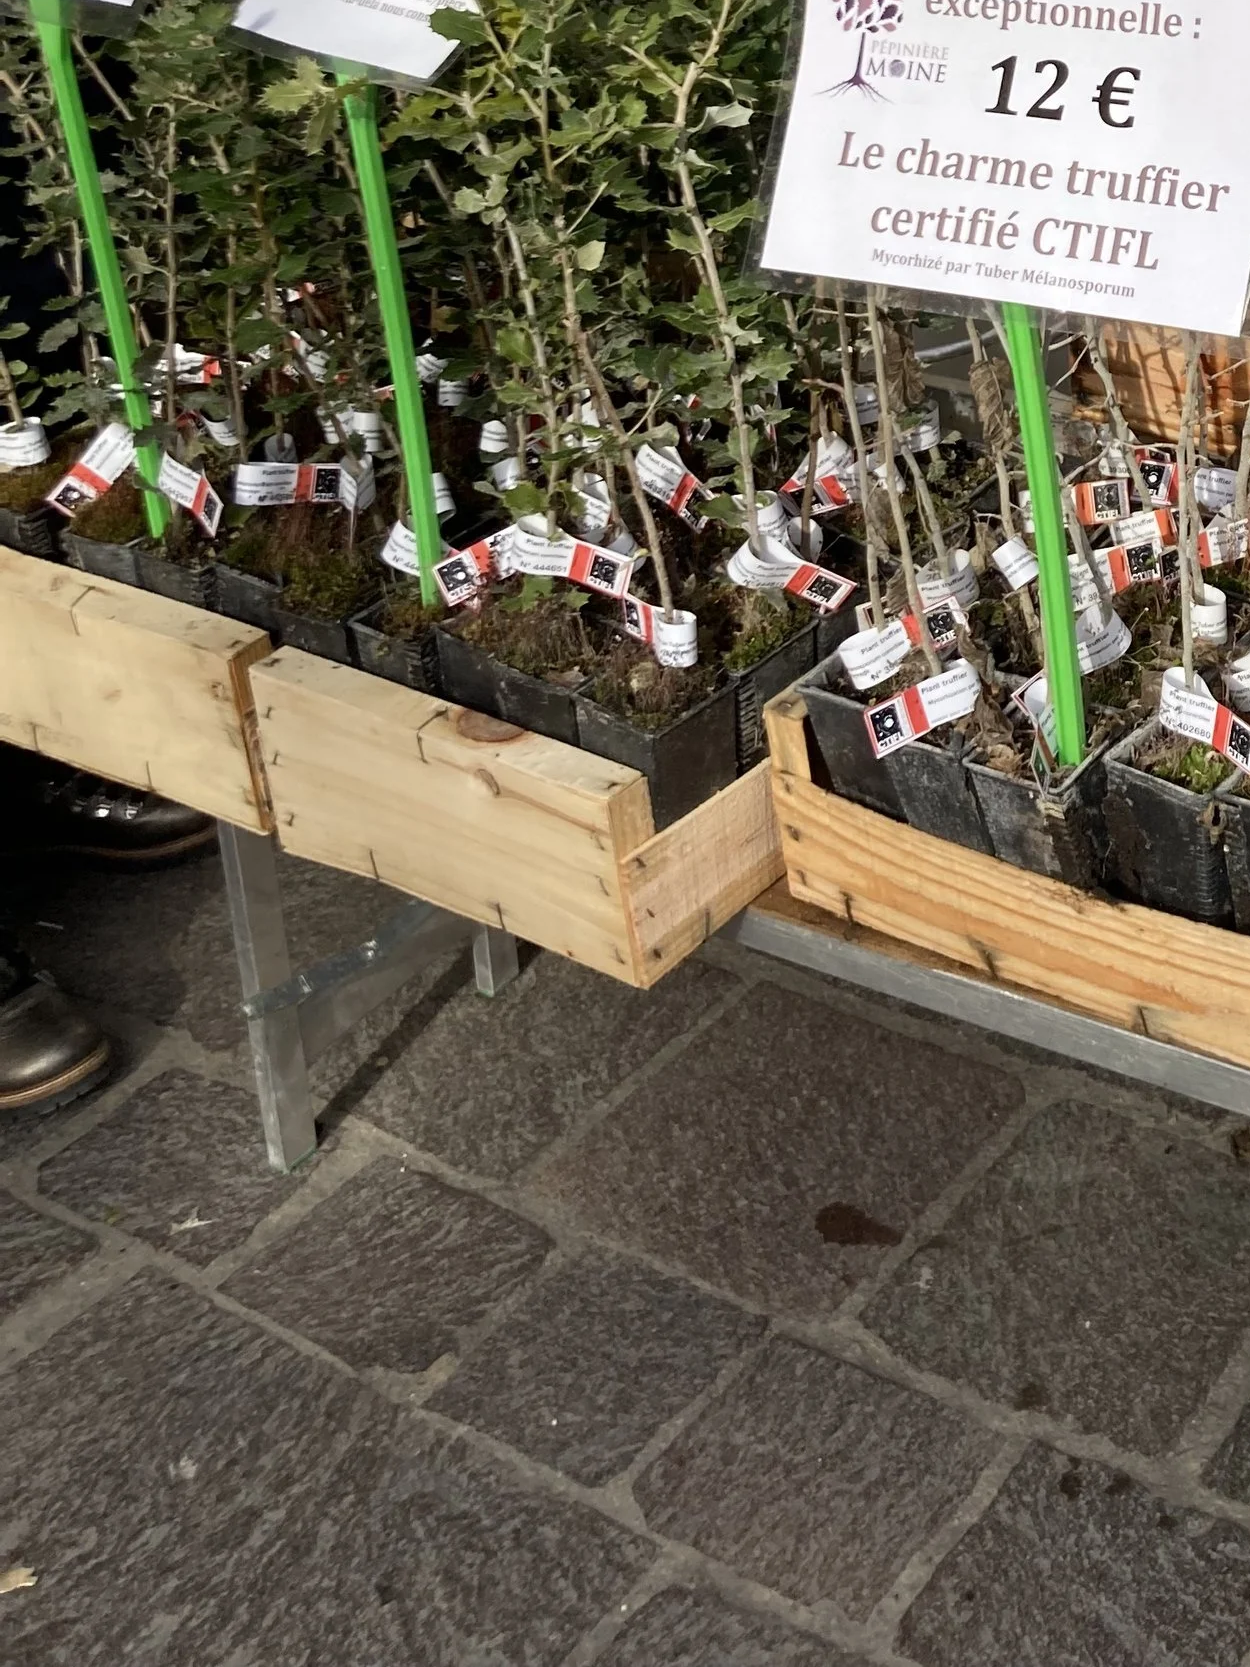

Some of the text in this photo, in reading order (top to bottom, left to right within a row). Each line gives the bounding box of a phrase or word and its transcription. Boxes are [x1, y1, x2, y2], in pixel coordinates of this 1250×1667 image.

[381, 2, 405, 17] nous
[870, 38, 950, 61] PÉPINIÈRE
[984, 55, 1142, 129] 12 €
[838, 131, 1230, 214] Le charme truffier
[870, 203, 1159, 270] certifié CTIFL
[871, 248, 1136, 300] Mycorhizé par Tuber Mélanosporum
